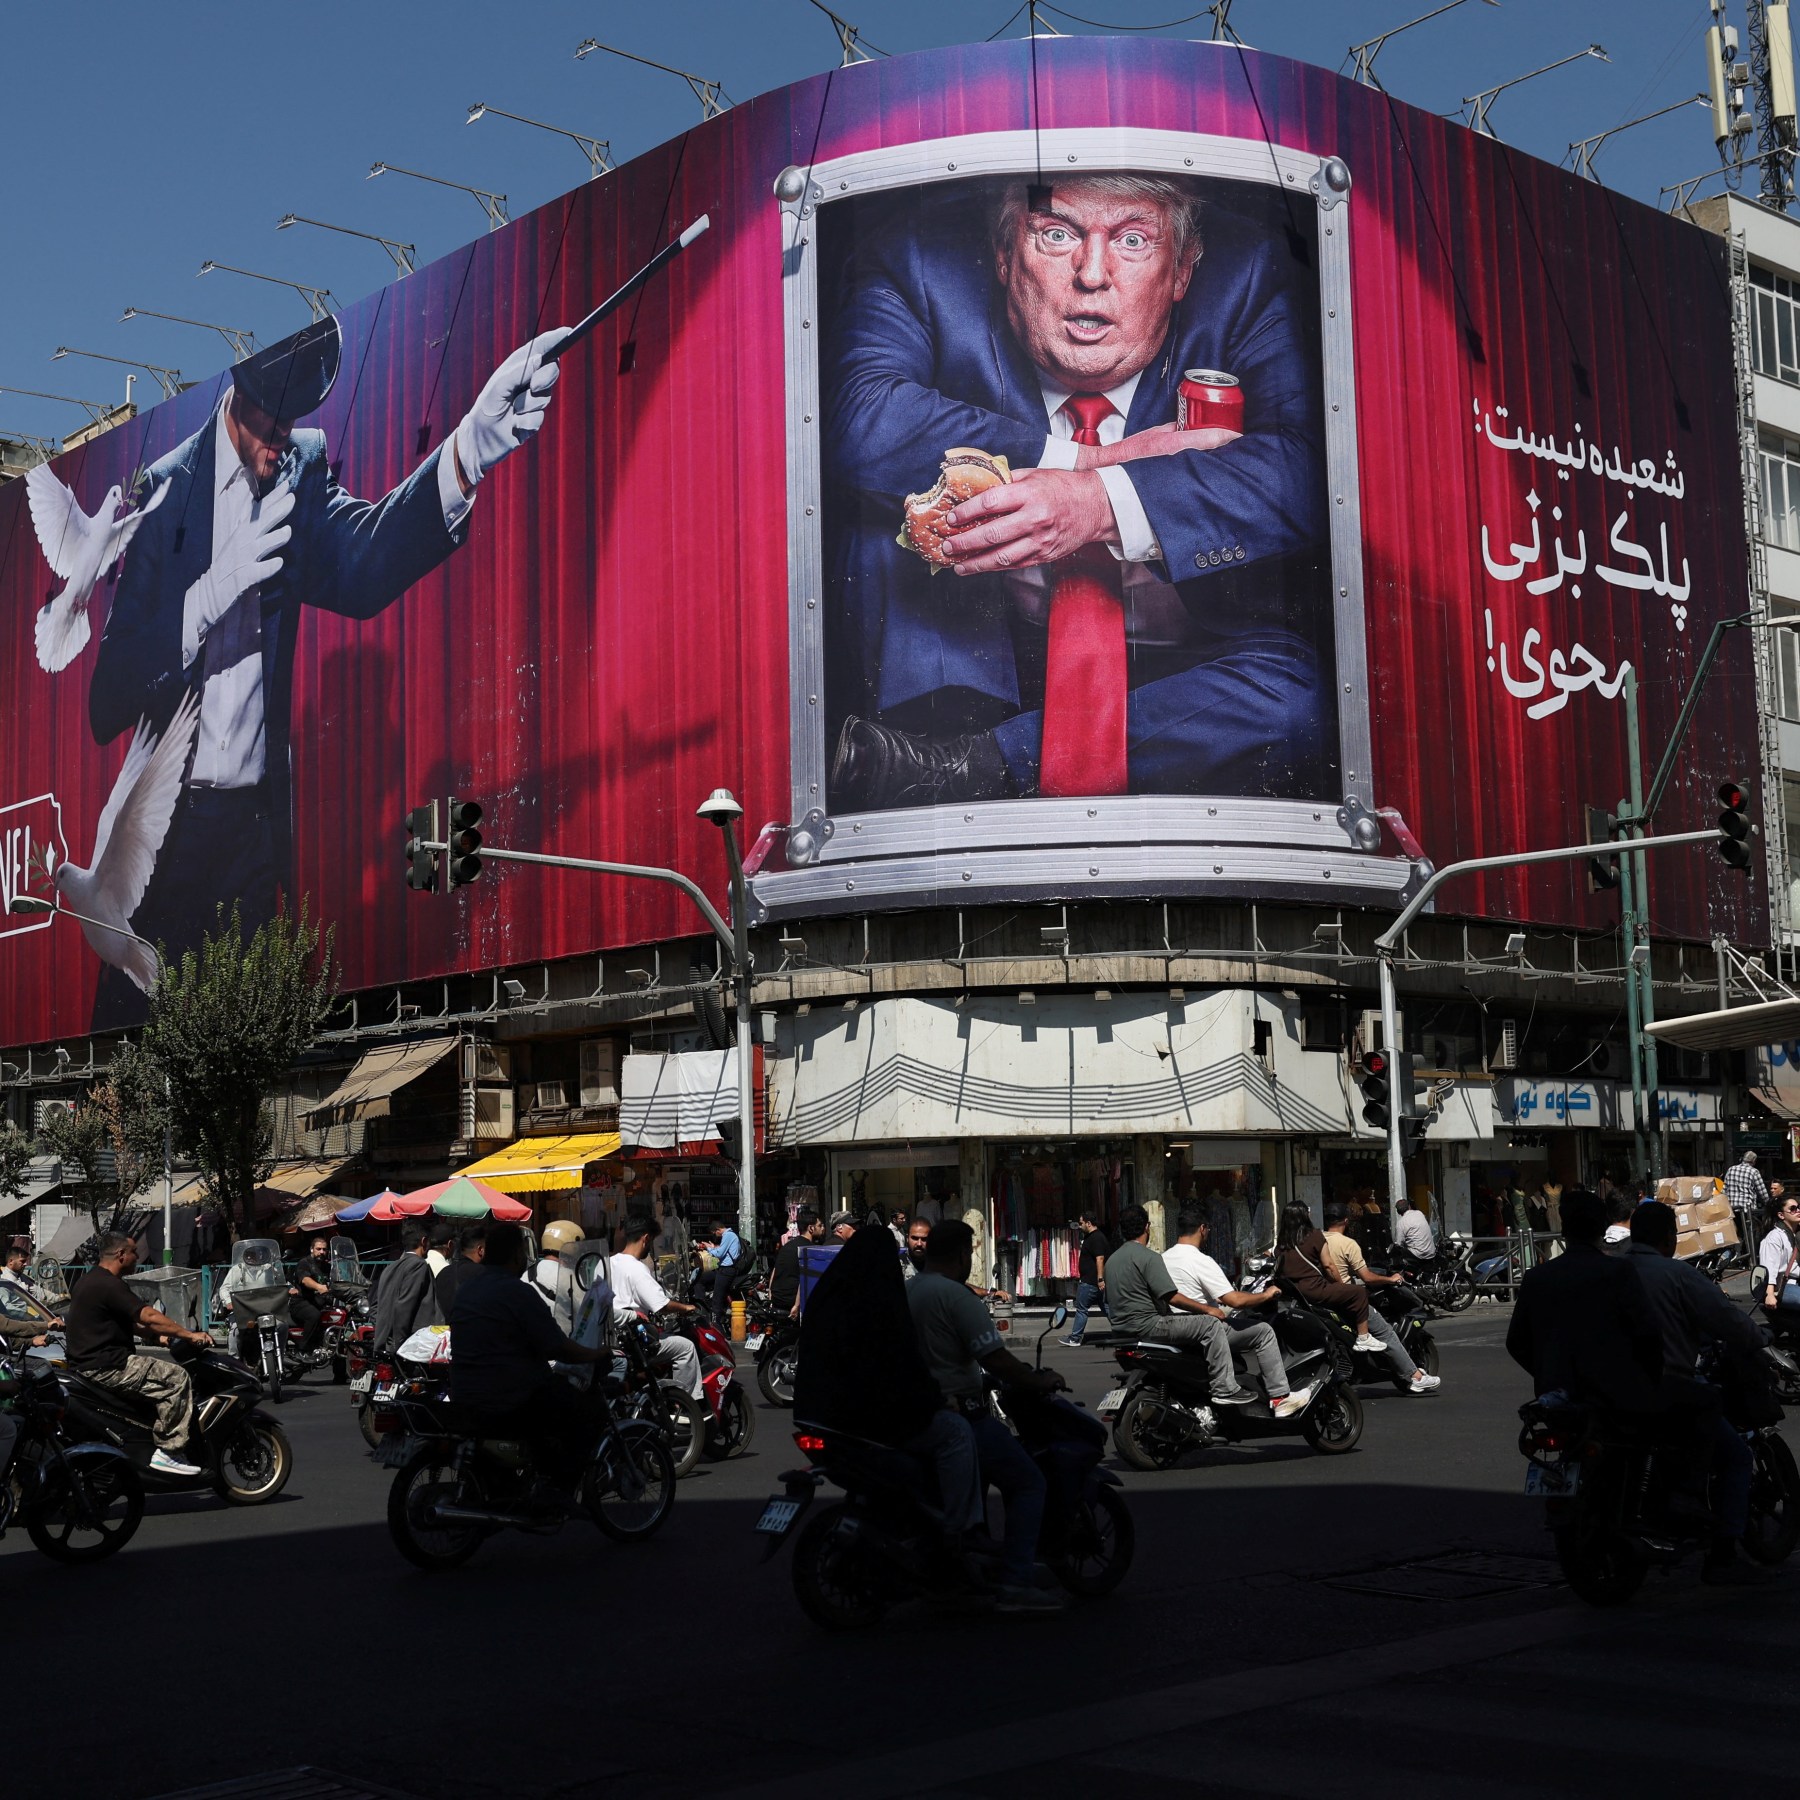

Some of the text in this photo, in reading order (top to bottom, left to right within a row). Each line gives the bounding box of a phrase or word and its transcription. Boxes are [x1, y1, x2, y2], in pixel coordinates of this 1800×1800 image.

[1589, 443, 1685, 499] شعبده
[1481, 487, 1692, 632] پلک بزنی
[1545, 1081, 1591, 1119] کوه
